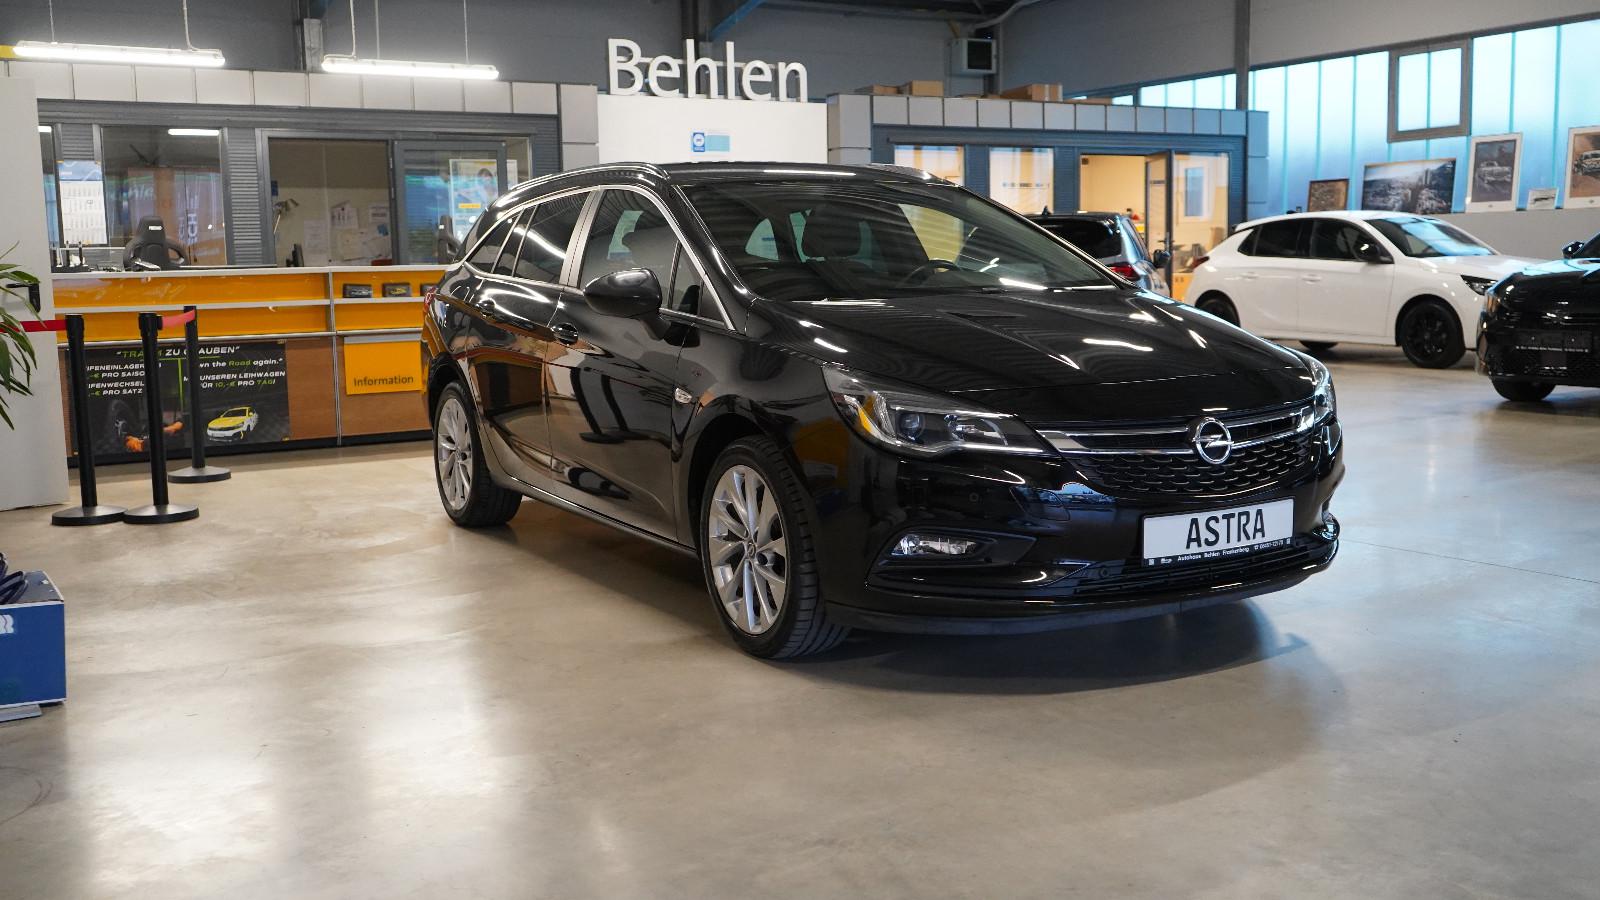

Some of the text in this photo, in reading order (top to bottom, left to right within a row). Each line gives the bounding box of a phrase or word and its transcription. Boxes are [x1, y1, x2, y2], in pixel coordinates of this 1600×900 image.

[607, 38, 808, 103] Behlen
[200, 371, 286, 381] UNSEREN LEIHWAGEN
[353, 375, 414, 387] Information
[1185, 508, 1266, 550] ASTRA
